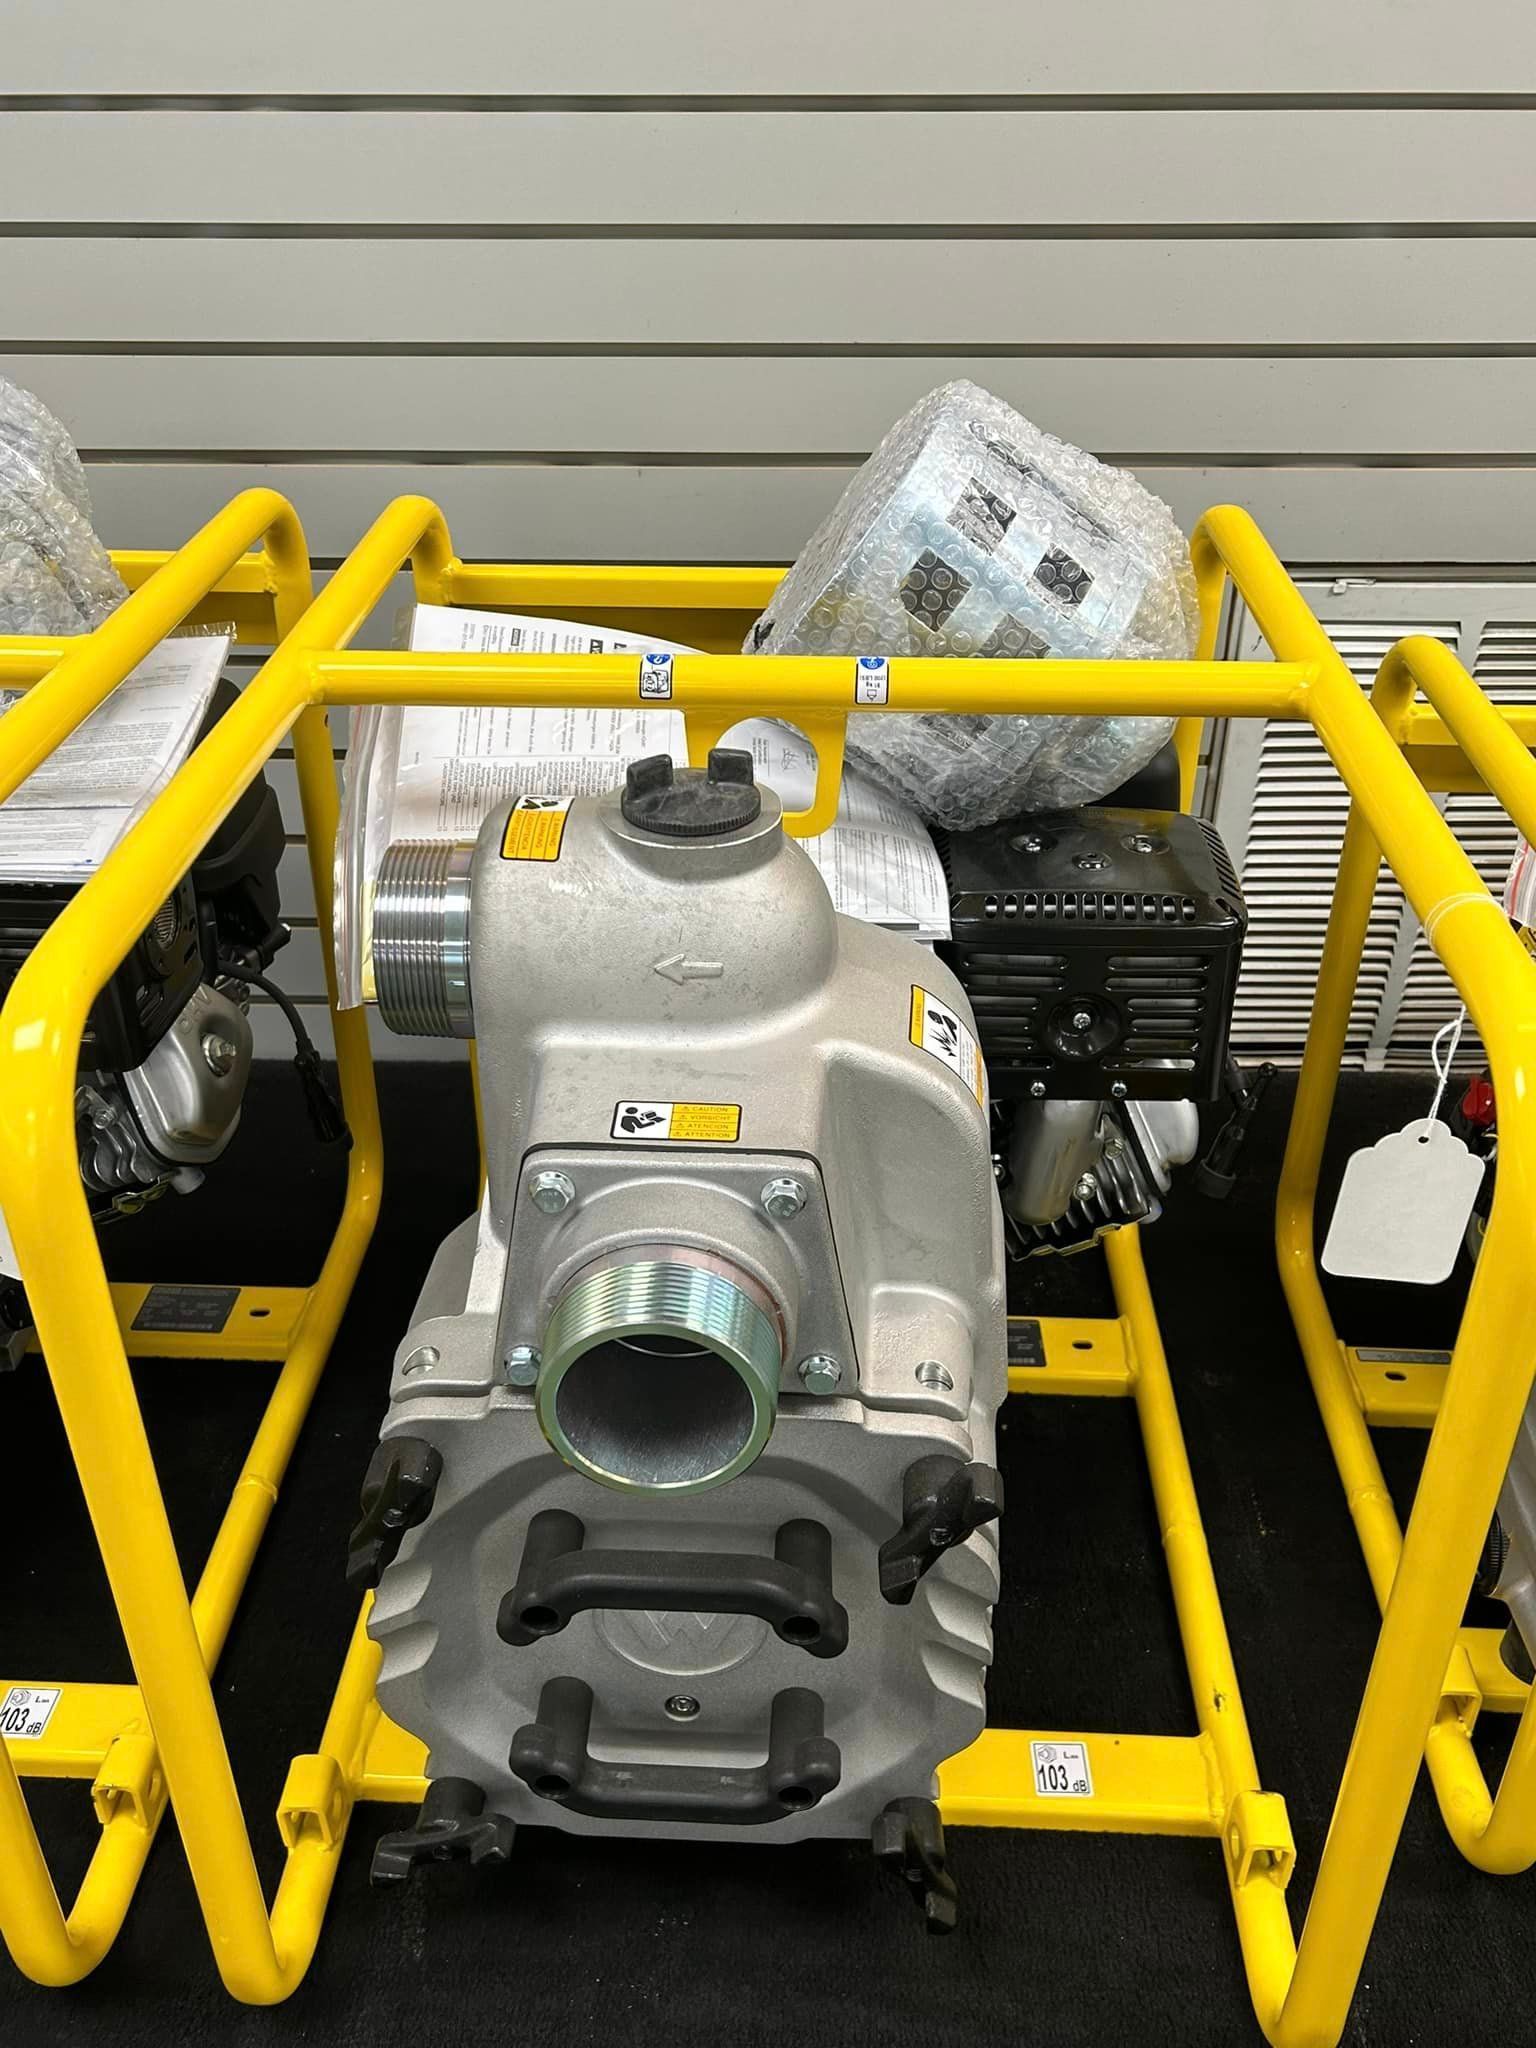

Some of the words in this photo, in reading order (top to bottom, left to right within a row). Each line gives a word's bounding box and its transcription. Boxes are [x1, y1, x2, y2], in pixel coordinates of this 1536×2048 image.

[692, 1105, 728, 1113] CAUTION
[0, 1707, 30, 1731] 103
[26, 1721, 42, 1733] dB
[1038, 1764, 1069, 1790] 103
[1072, 1779, 1087, 1792] dB
